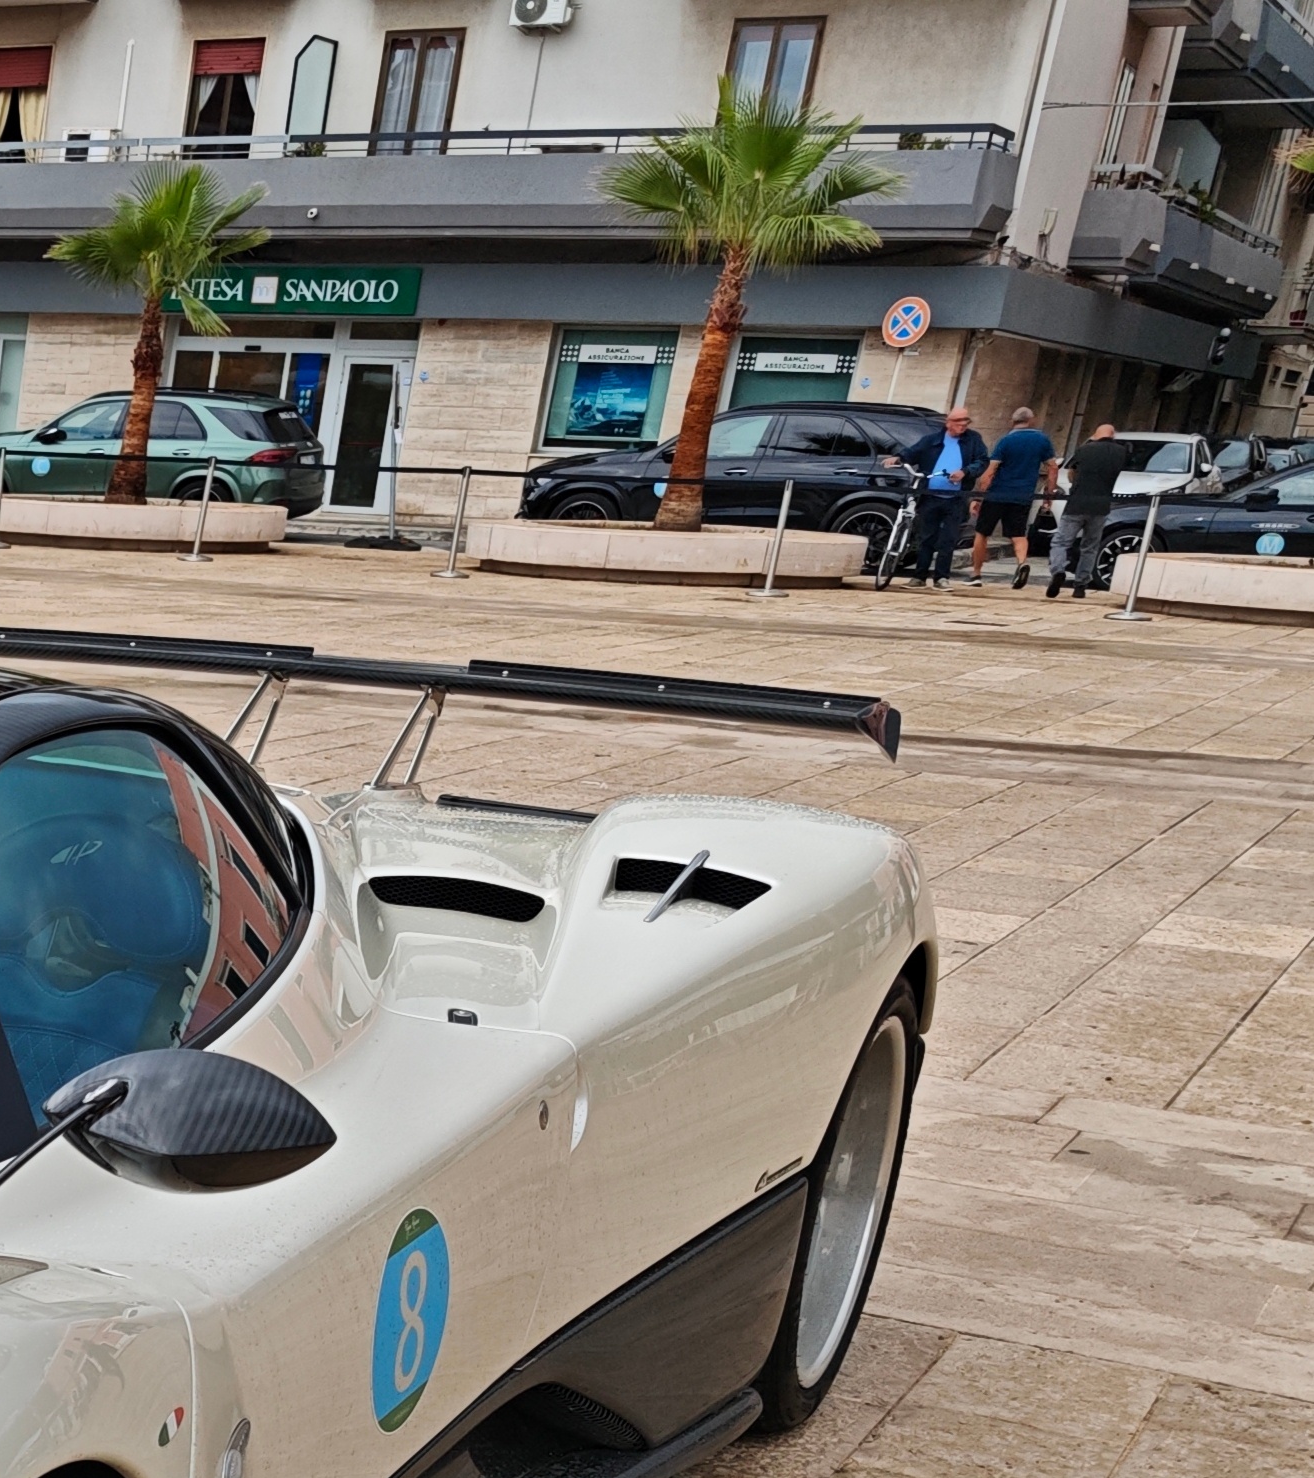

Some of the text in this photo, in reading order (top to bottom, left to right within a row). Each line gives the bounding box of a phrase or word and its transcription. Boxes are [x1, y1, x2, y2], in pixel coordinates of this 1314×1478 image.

[283, 278, 399, 303] SANPAOLO
[763, 362, 826, 371] ASSICURAZIONE
[783, 355, 809, 363] BANCA
[394, 1249, 428, 1394] 8
